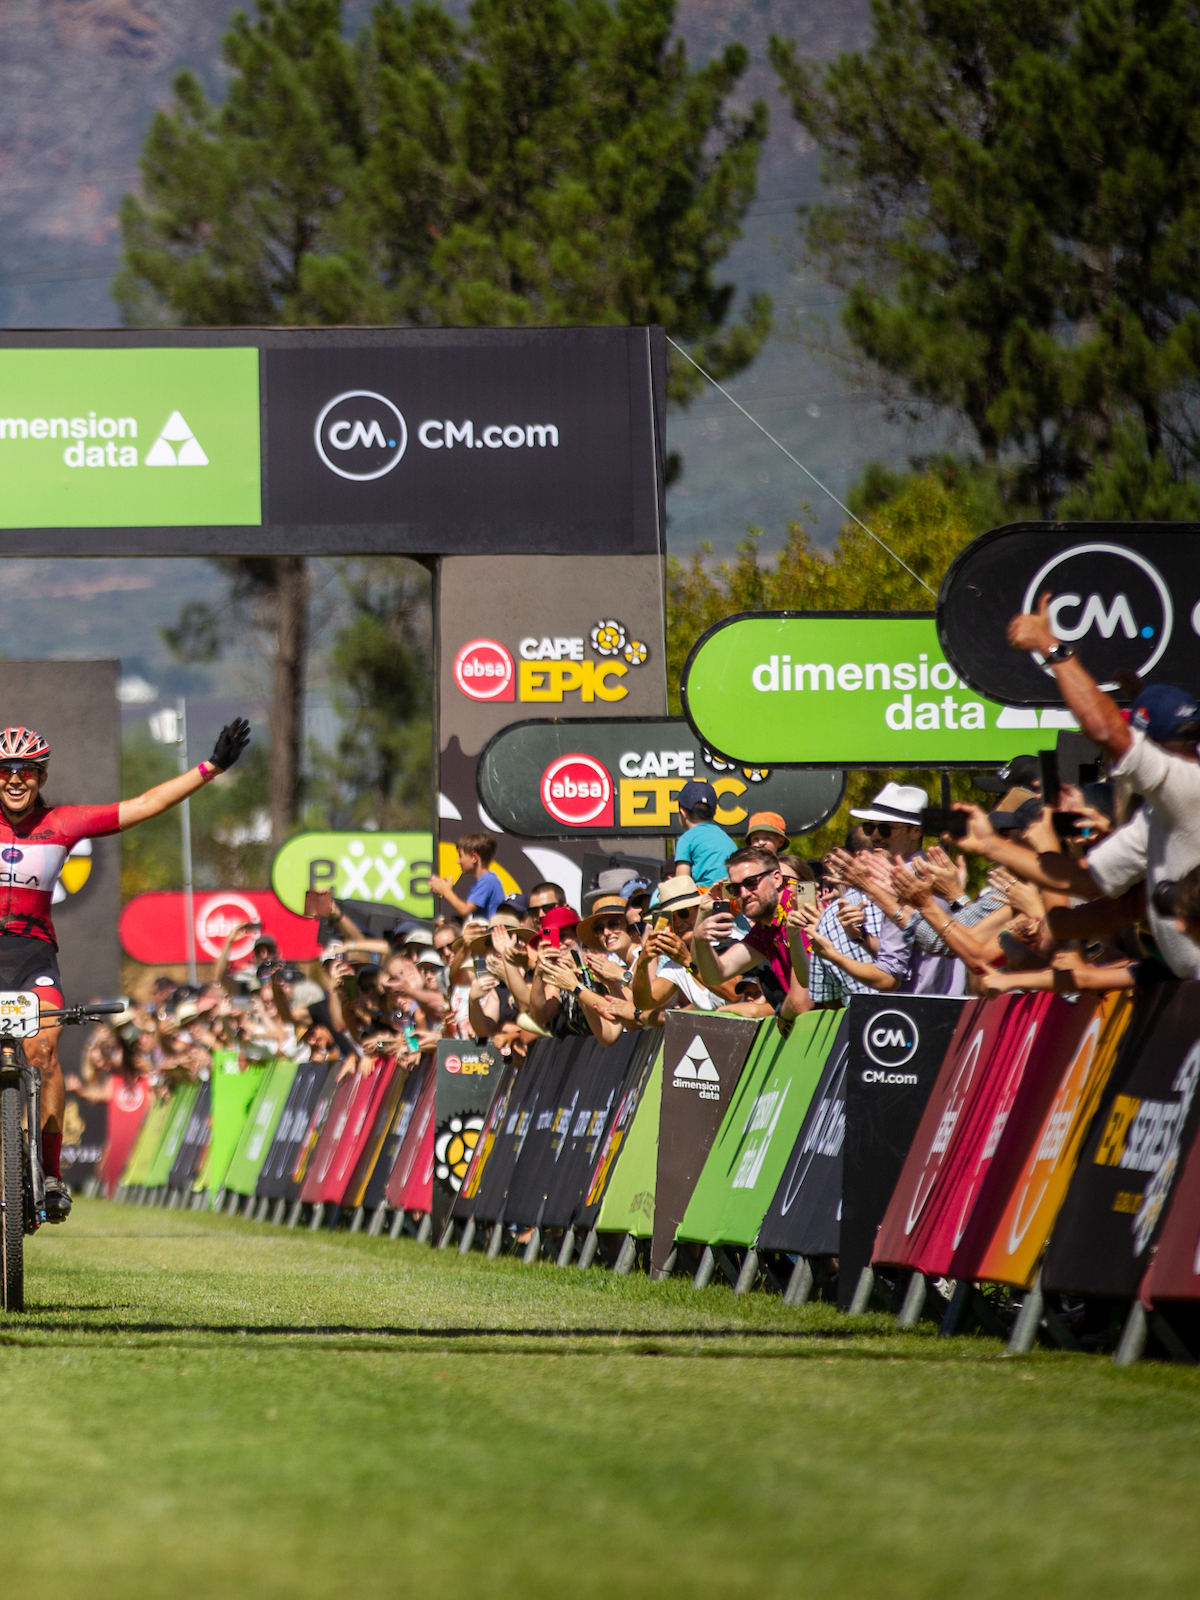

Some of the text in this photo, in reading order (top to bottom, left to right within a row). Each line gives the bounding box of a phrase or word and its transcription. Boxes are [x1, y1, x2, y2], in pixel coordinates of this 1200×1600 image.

[418, 420, 559, 449] CM.com
[63, 440, 138, 467] data
[519, 637, 584, 660] CAPE
[462, 658, 505, 678] absa
[752, 653, 968, 692] dimensio
[519, 660, 629, 702] EPIC
[885, 693, 985, 731] data
[619, 751, 695, 778] CAPE
[552, 776, 602, 798] absa
[619, 777, 749, 827] EPC
[309, 841, 434, 901] exxa
[1, 1006, 26, 1015] EPIC
[462, 1062, 490, 1075] EPIC
[861, 1071, 918, 1086] CM.com
[672, 1078, 720, 1092] dimension
[699, 1089, 720, 1101] data
